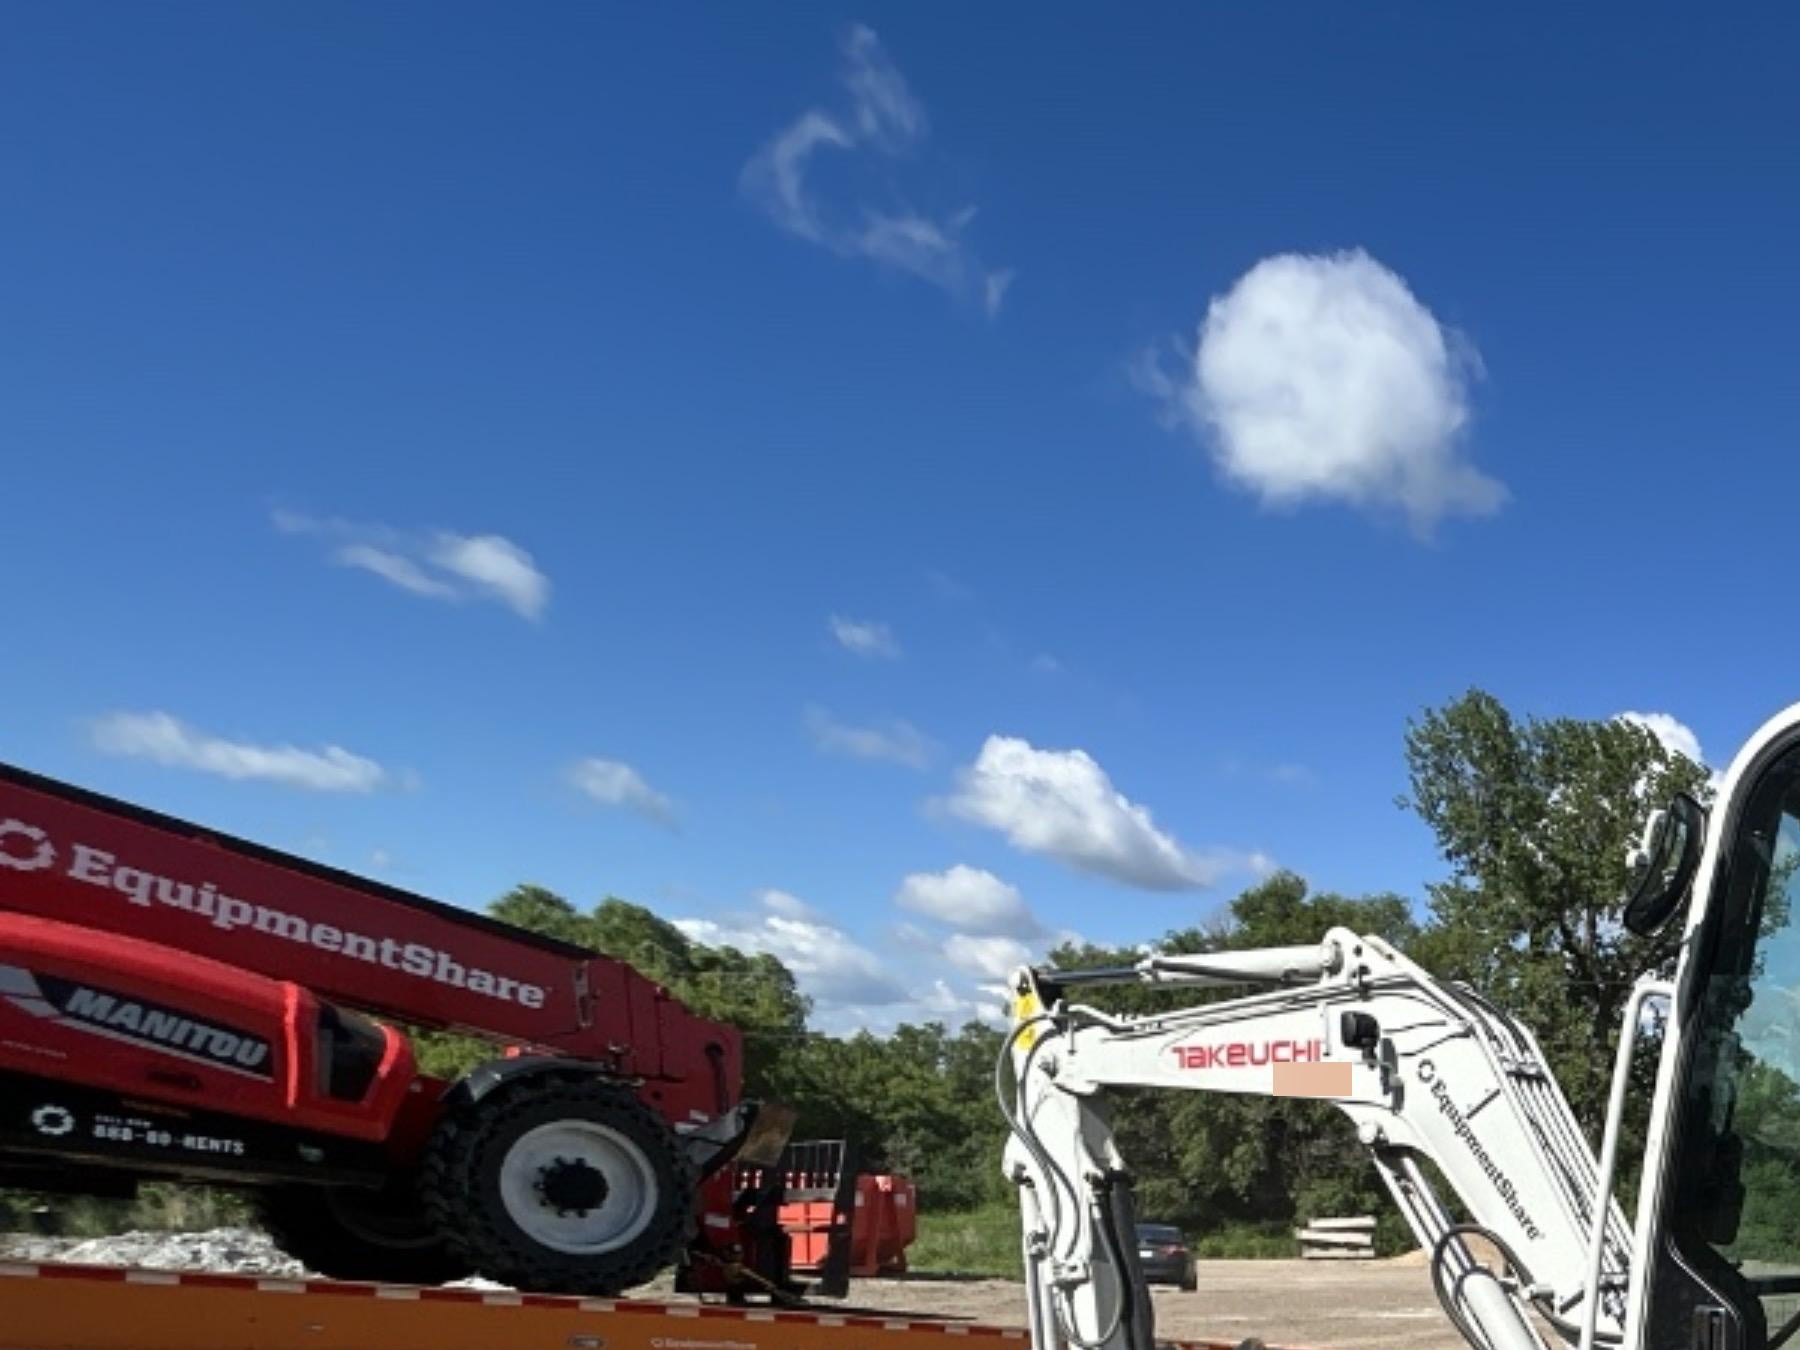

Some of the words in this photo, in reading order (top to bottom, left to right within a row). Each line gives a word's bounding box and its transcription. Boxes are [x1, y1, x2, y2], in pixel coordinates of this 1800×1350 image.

[66, 842, 546, 1010] EquipmentShare
[65, 986, 269, 1066] MANITOU
[1430, 1079, 1540, 1241] EquipmentShare
